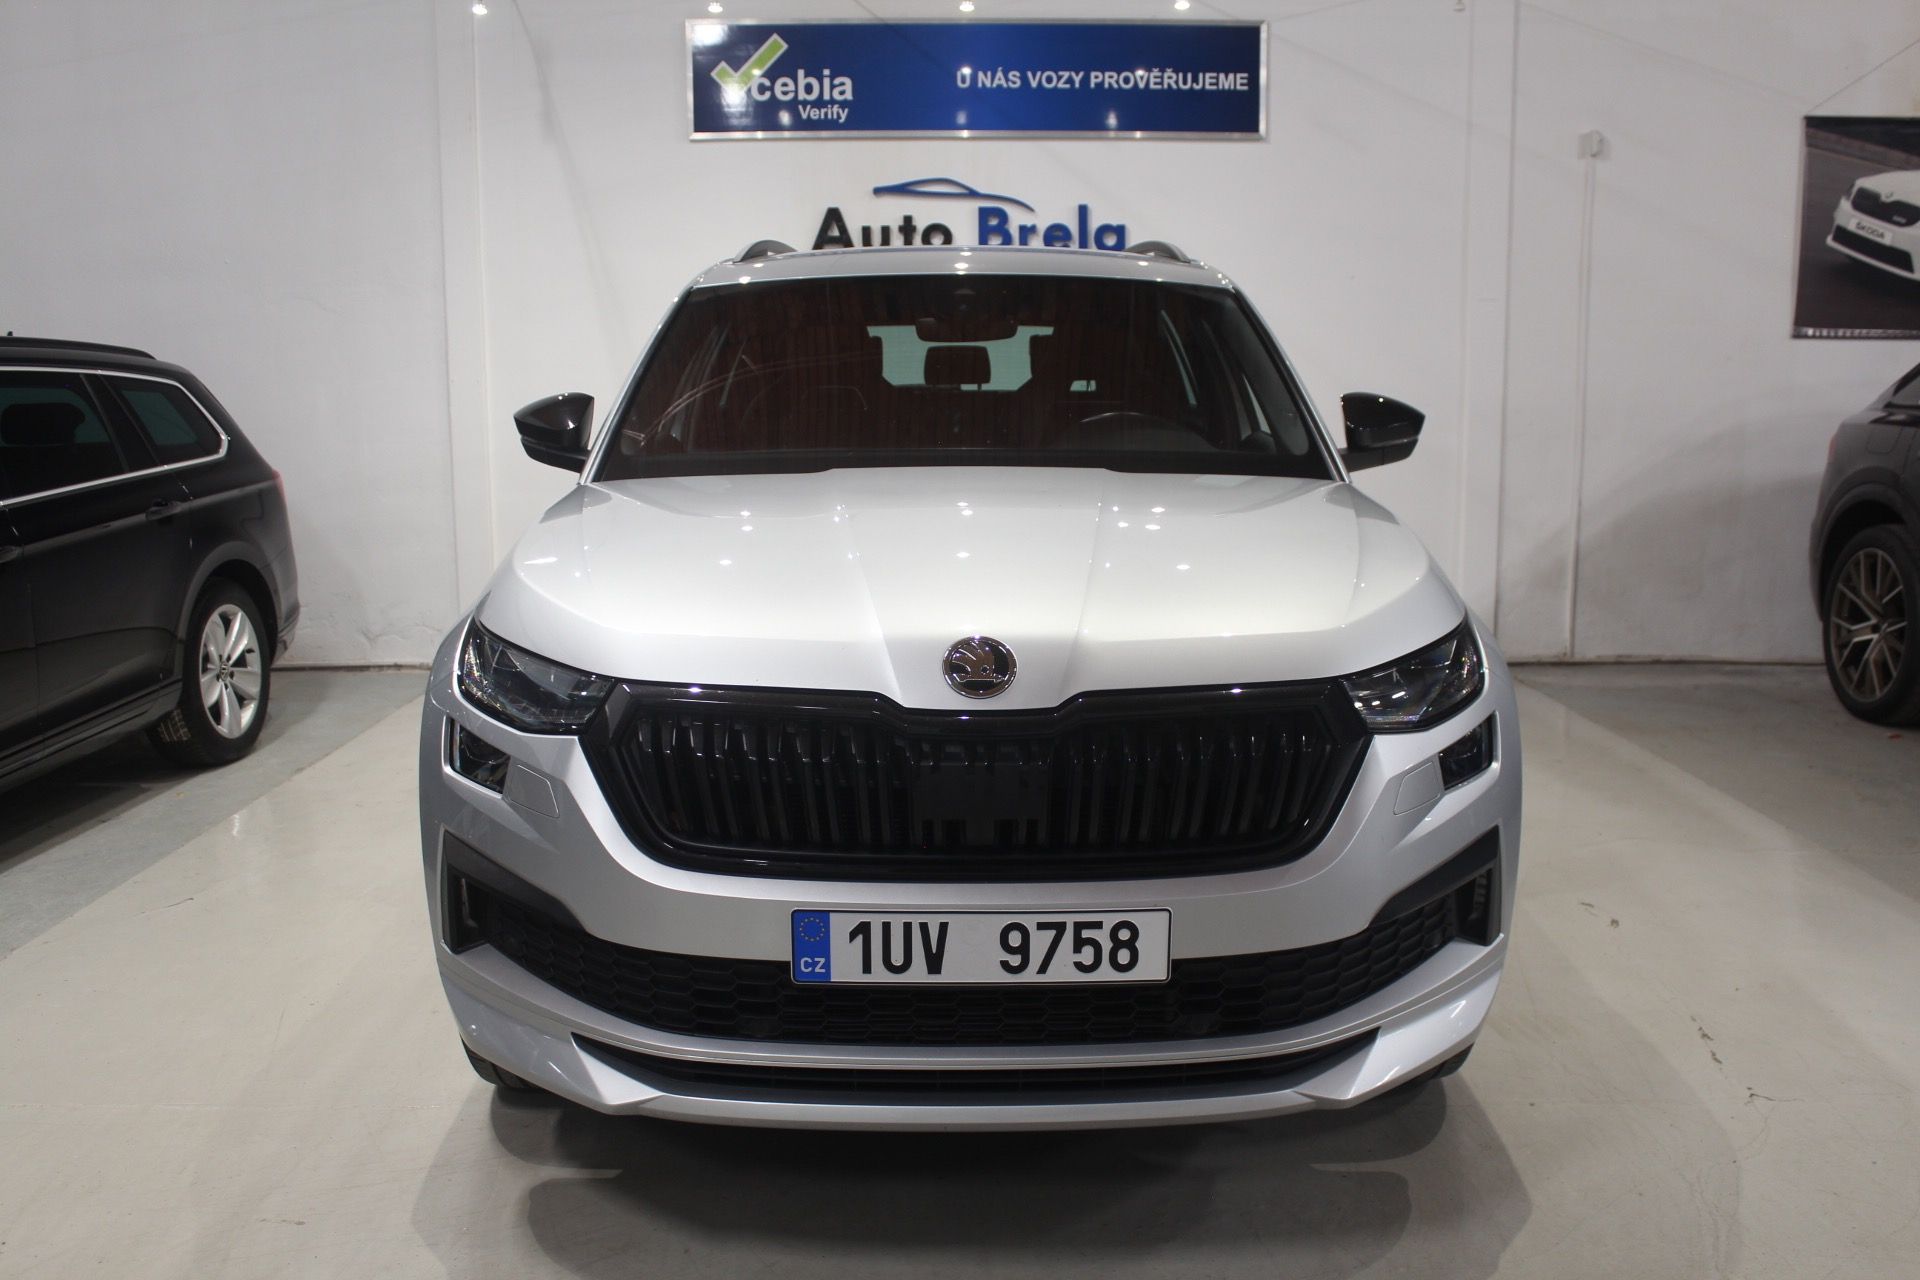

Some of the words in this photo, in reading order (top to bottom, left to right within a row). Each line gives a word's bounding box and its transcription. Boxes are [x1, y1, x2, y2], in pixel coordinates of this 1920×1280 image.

[751, 69, 854, 101] cebia
[977, 67, 1022, 89] NÁS
[1027, 71, 1084, 90] VOZY
[1090, 68, 1249, 91] PROVĚŘUJEME
[798, 104, 849, 123] Verify
[812, 206, 953, 250] Auto
[978, 204, 1126, 251] Brela
[848, 920, 949, 975] 1UV
[999, 919, 1140, 974] 9758
[800, 957, 826, 973] CZ
